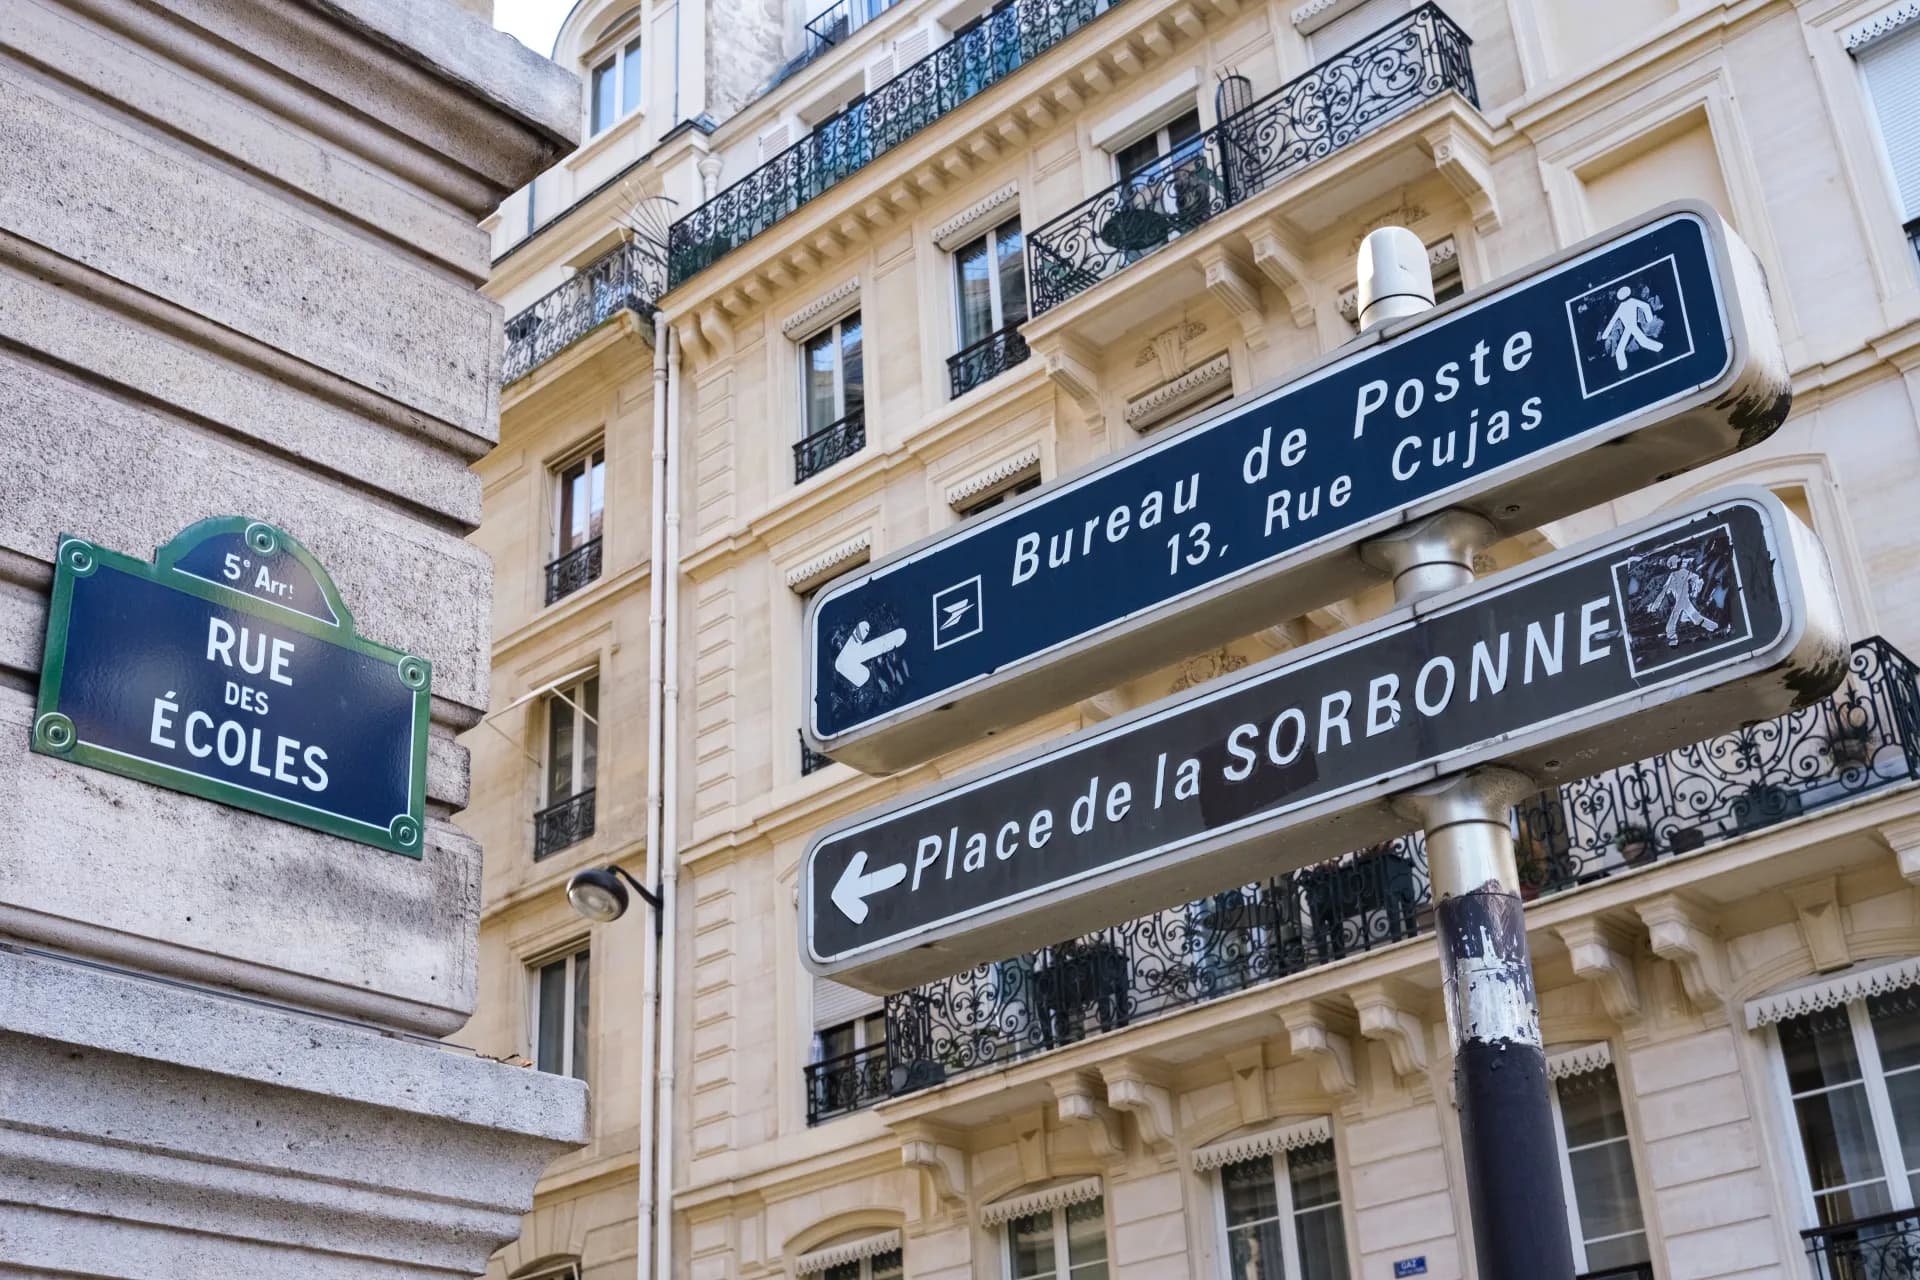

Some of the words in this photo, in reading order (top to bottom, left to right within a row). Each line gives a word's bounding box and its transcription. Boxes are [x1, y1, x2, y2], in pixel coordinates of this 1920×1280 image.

[1011, 473, 1200, 587] Bureau
[1243, 426, 1307, 484] de
[1353, 329, 1533, 439] Poste
[1167, 522, 1228, 575] 13,
[1264, 475, 1352, 537] Rue
[1391, 396, 1543, 481] Cujas
[206, 616, 295, 686] RUE
[224, 681, 269, 716] DES
[150, 691, 329, 792] ÉCOLES
[911, 809, 1053, 892] Place
[1070, 776, 1132, 835] de
[1154, 752, 1200, 809] la
[1223, 596, 1611, 782] SORBONNE
